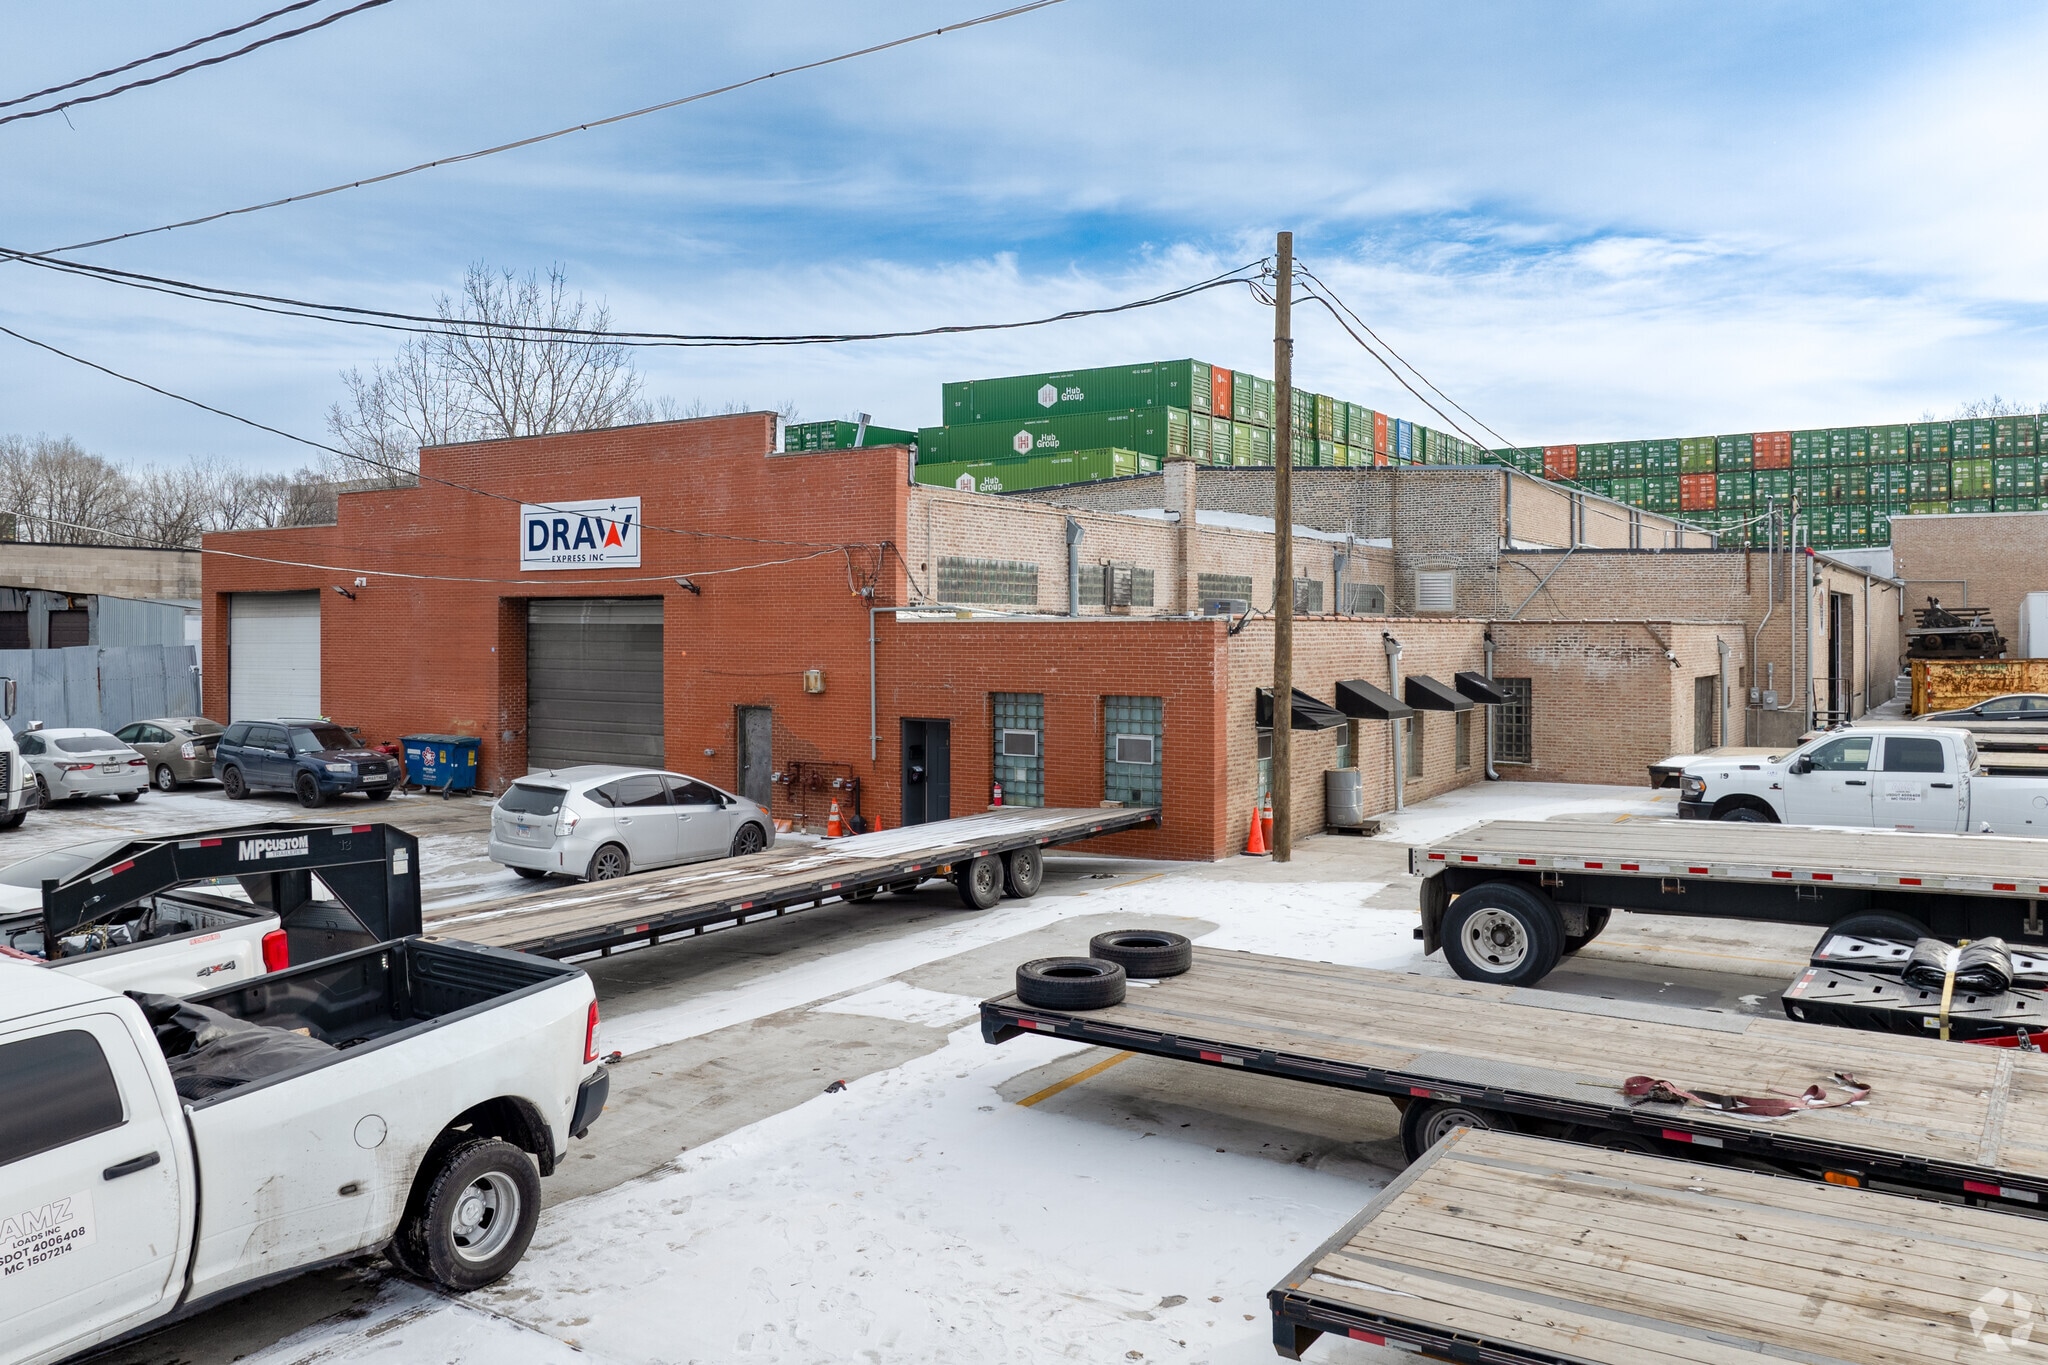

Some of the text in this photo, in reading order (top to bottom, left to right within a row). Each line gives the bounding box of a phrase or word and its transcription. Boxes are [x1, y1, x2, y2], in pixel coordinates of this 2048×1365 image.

[1061, 393, 1084, 402] Group
[1041, 433, 1056, 441] Hub
[1036, 439, 1060, 449] Group
[984, 477, 999, 485] Hub
[979, 483, 1003, 492] Group
[529, 514, 632, 552] DRAW
[552, 553, 604, 563] EXPRESS INC
[265, 835, 309, 851] CUSTOM
[12, 1226, 61, 1249] LOADS INC
[32, 1226, 86, 1253] 4006408
[4, 1243, 73, 1276] MC 1507214
